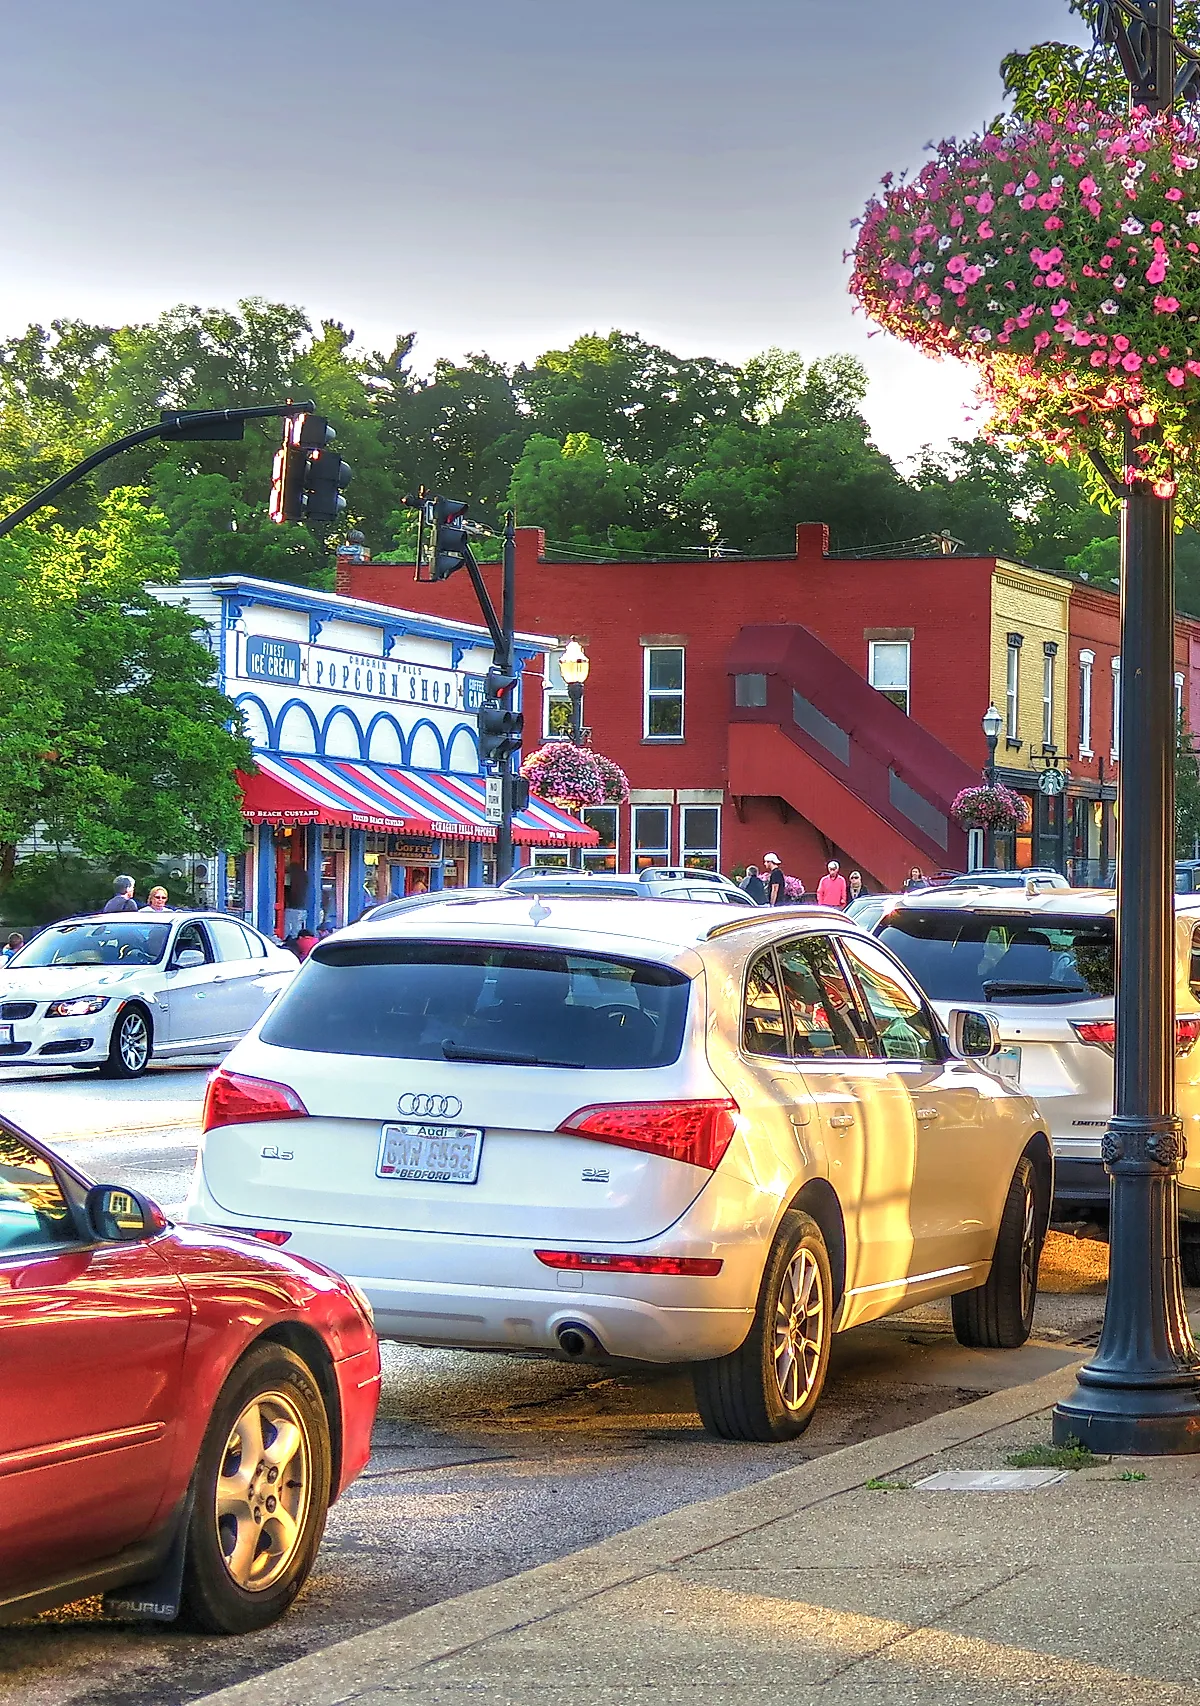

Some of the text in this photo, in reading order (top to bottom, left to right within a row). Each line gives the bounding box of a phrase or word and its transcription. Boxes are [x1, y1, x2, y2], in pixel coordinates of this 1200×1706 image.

[262, 642, 285, 657] FINEST
[251, 653, 296, 679] ICE CREAM
[349, 655, 422, 676] CHAGRIN FALLS
[316, 660, 450, 704] POPCORN SHOP
[490, 782, 498, 792] NO
[488, 794, 500, 805] TURN
[486, 807, 501, 818] ON RED
[395, 841, 432, 853] COFFEE
[418, 1126, 448, 1137] Audi
[260, 1145, 294, 1161] Q5
[400, 1168, 451, 1180] BEDFORD
[107, 1600, 175, 1615] TAURUS
